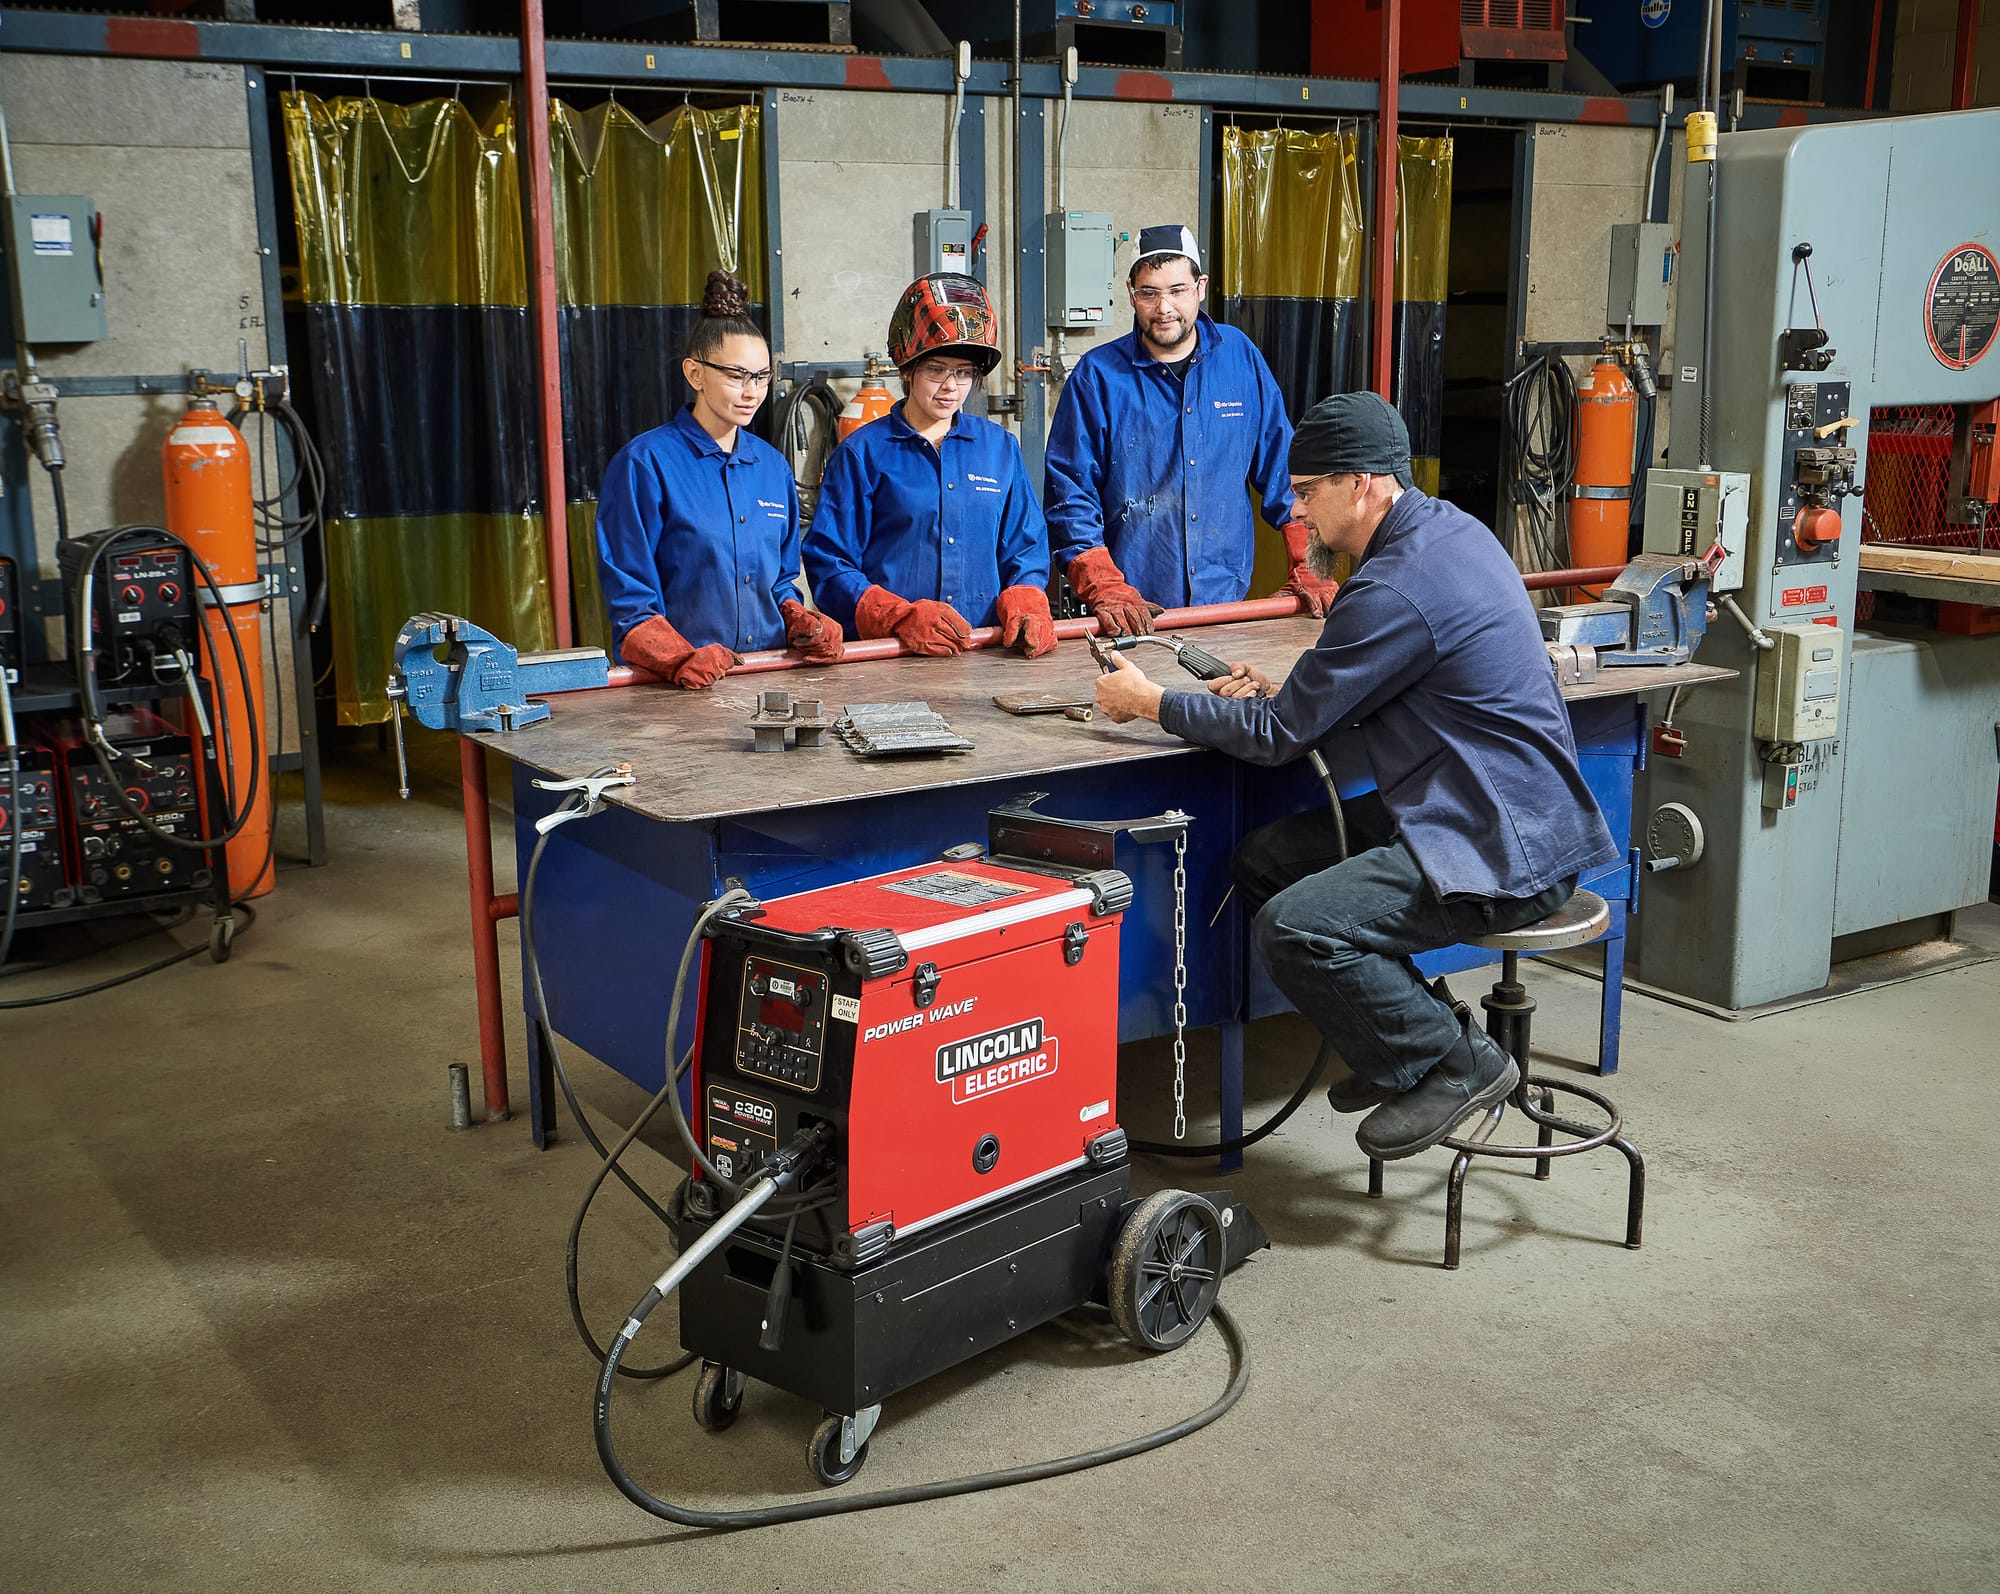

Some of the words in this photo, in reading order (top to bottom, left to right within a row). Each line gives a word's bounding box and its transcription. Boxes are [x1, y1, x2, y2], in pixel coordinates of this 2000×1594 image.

[1529, 283, 1537, 294] 2
[240, 295, 250, 310] 5
[1686, 492, 1695, 508] ON
[1684, 529, 1692, 552] OFF
[837, 997, 859, 1009] STAFF
[837, 1008, 856, 1019] ONLY
[864, 1013, 924, 1043] POWER
[943, 1025, 1037, 1076] LINCOLN
[965, 1053, 1048, 1096] ELECTRIC
[734, 1109, 755, 1120] POWER
